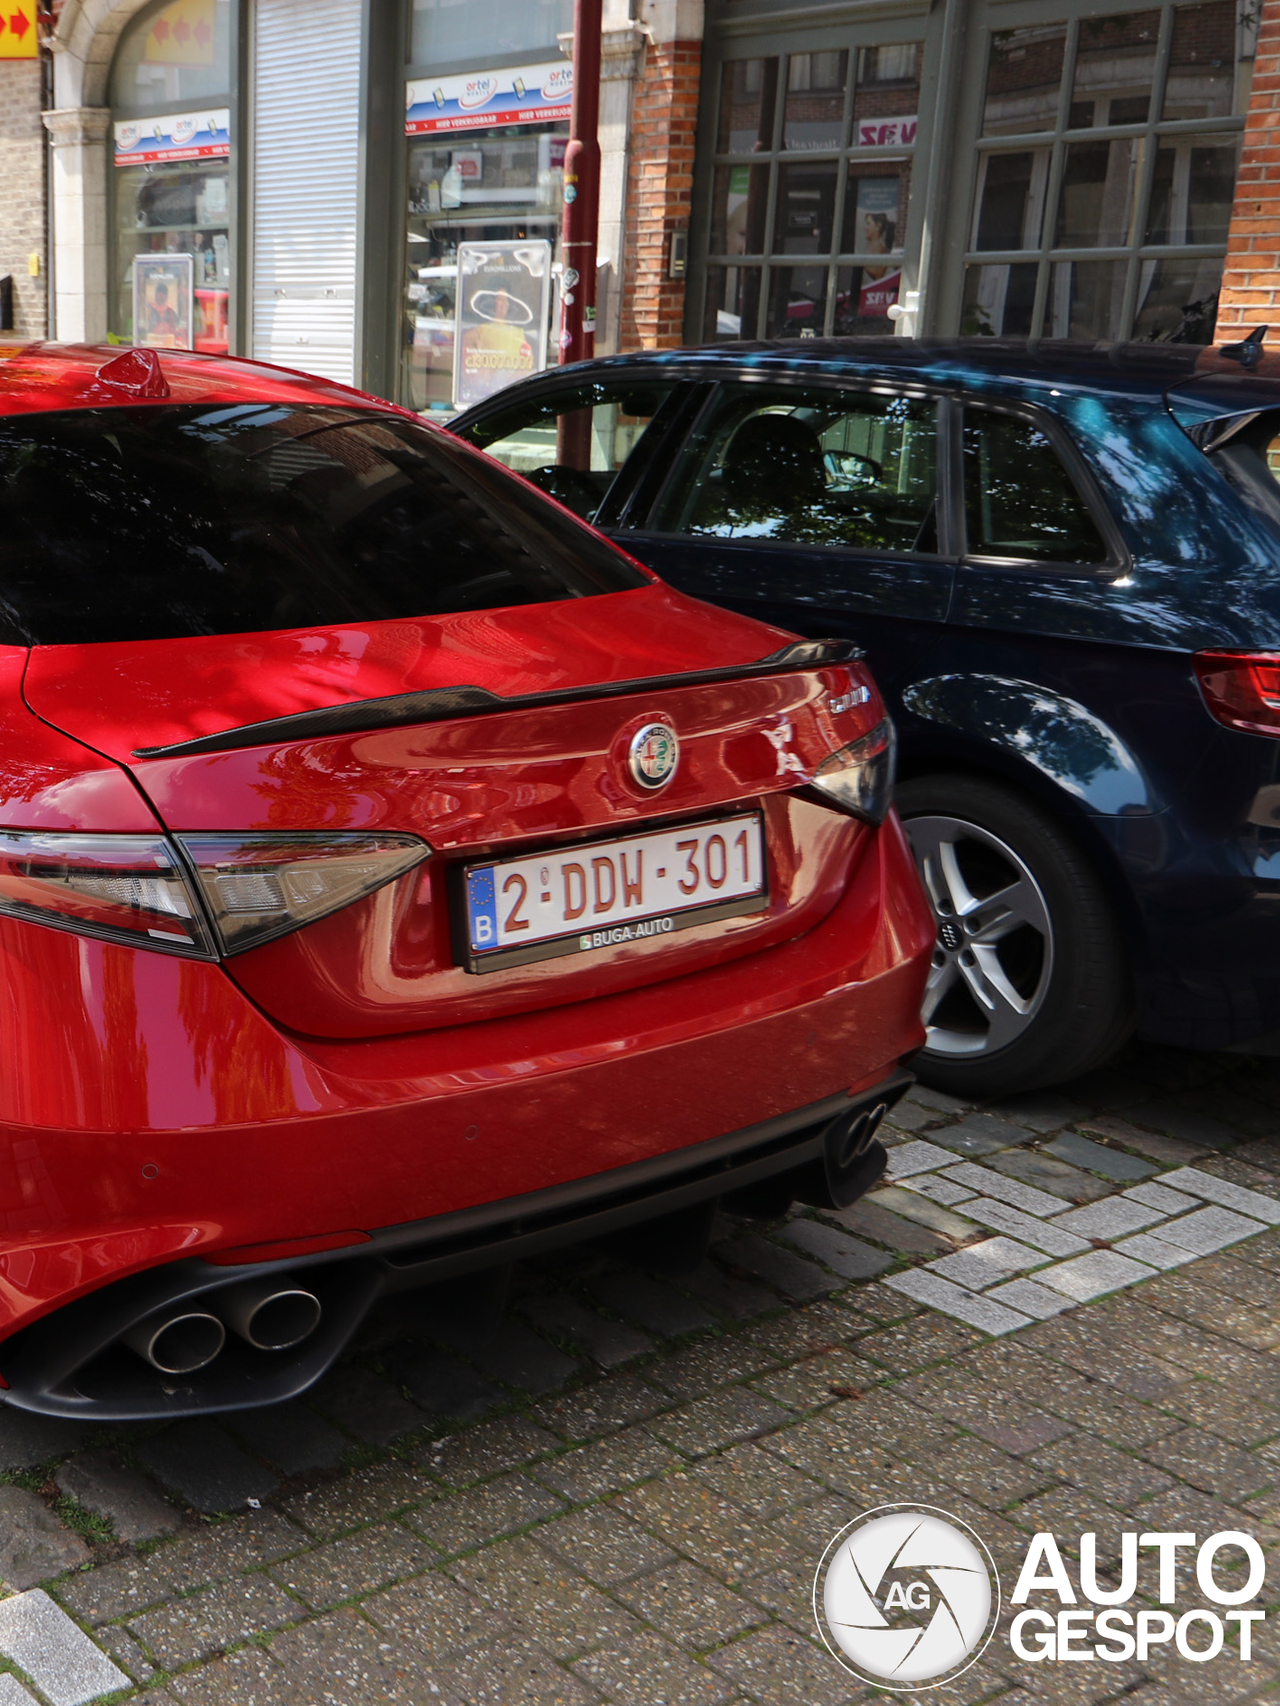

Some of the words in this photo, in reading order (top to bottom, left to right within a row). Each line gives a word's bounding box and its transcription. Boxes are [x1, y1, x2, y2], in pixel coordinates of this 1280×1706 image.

[466, 79, 490, 91] ortel
[549, 69, 572, 81] orte
[475, 915, 492, 943] B
[593, 917, 673, 948] BUGA-AUTO
